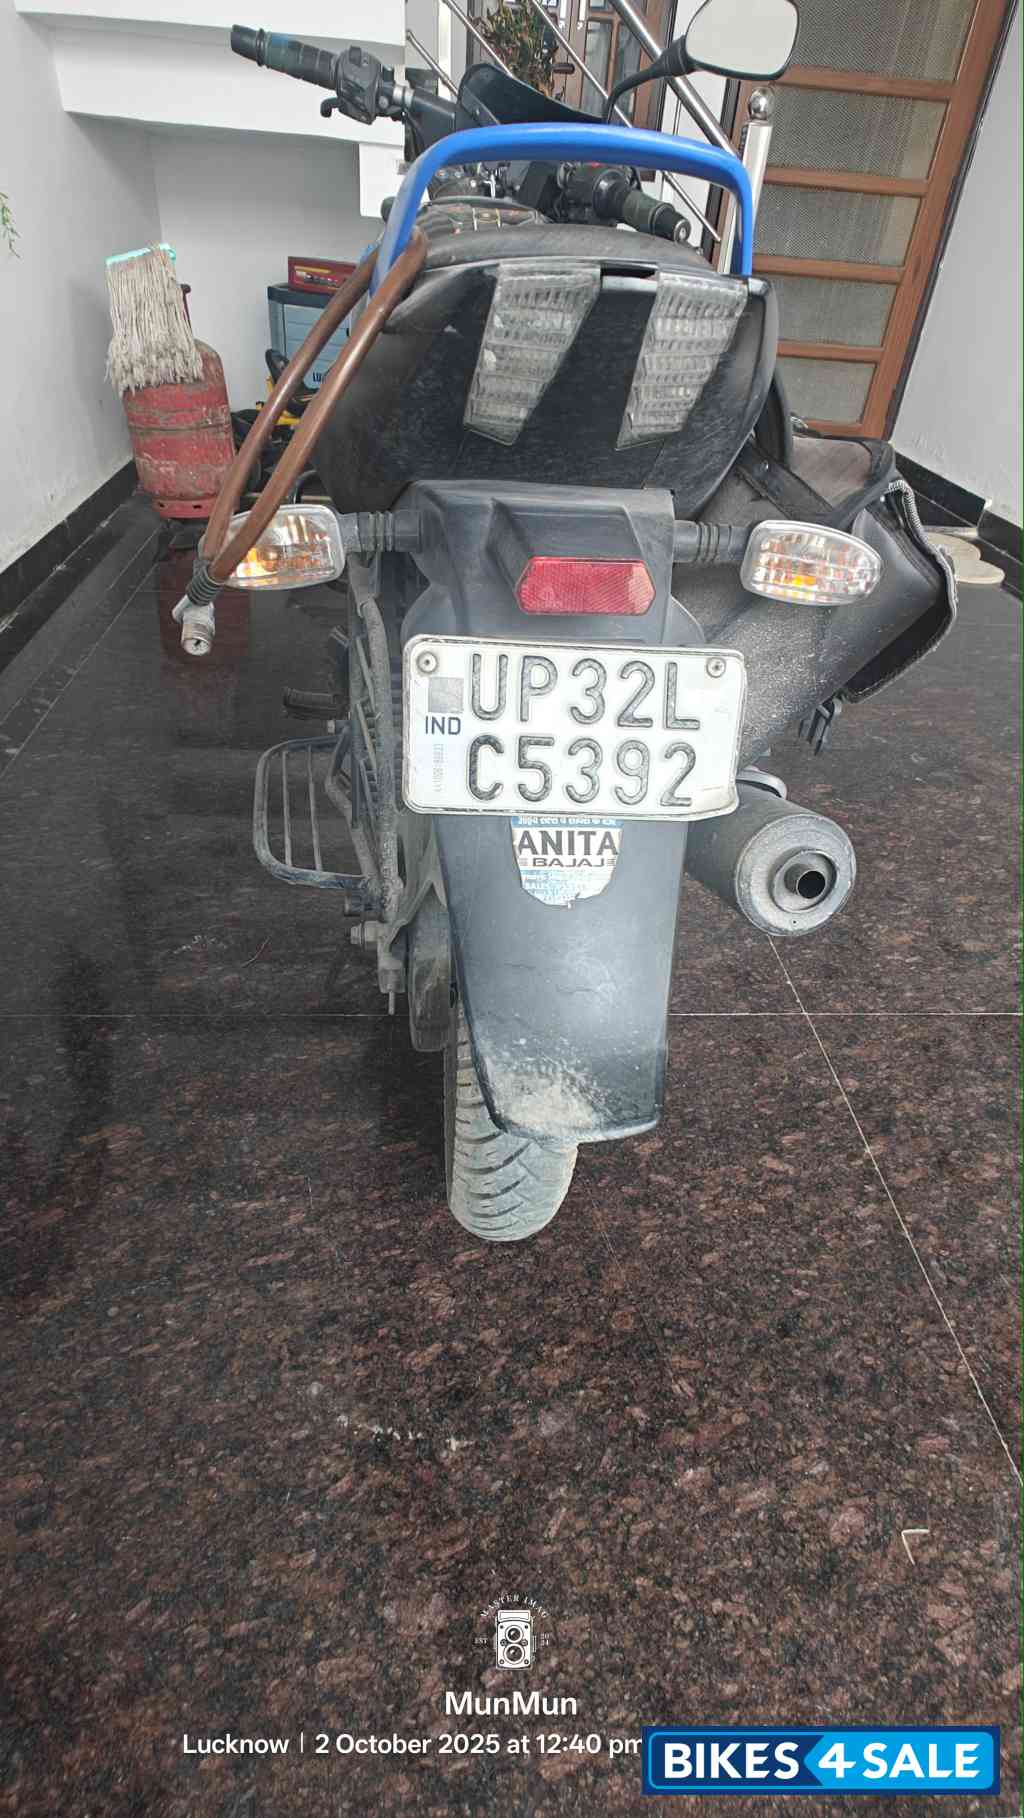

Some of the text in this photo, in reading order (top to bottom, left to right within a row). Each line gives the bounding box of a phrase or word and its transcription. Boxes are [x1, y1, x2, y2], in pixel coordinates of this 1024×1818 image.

[470, 653, 701, 731] UP32L
[424, 716, 462, 735] IND
[468, 734, 697, 807] C5392
[518, 830, 619, 856] ANITA
[532, 857, 605, 868] BAJAJ
